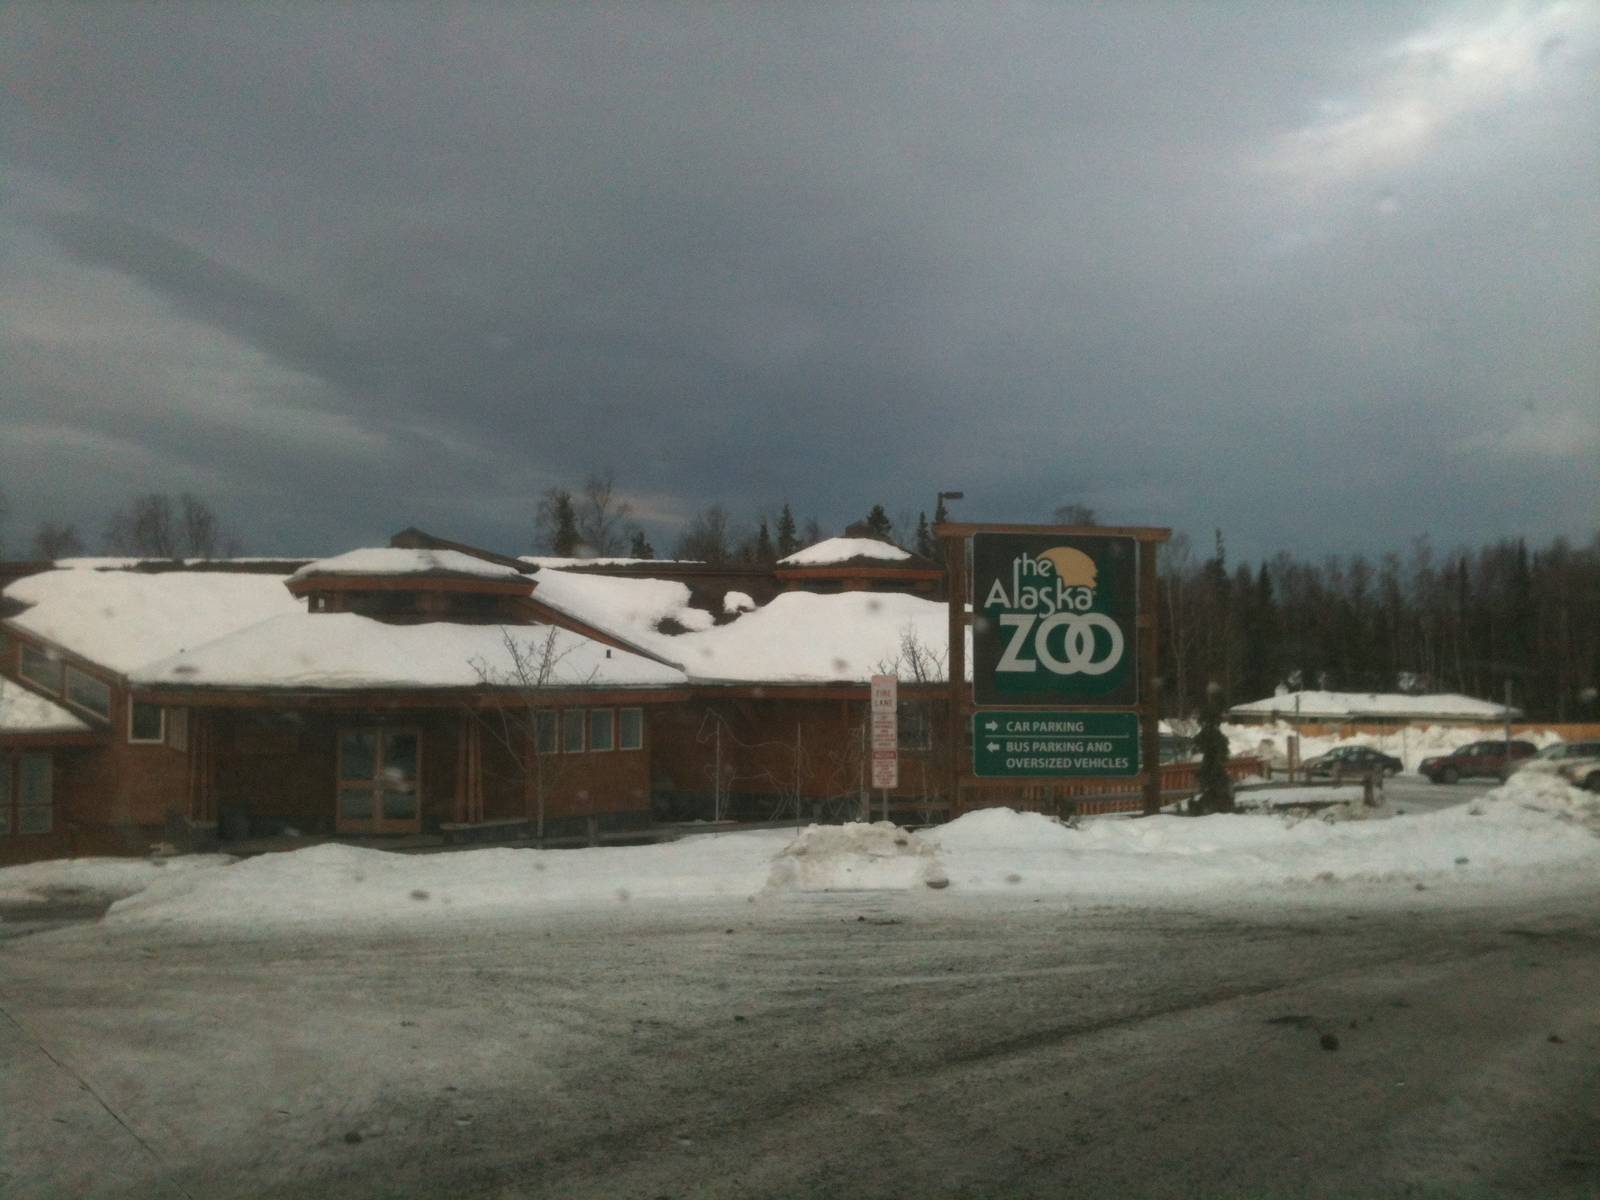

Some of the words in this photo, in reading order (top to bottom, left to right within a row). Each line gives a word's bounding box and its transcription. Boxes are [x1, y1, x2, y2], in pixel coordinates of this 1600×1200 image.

[1013, 552, 1052, 577] the
[984, 576, 1092, 618] Alaska
[995, 612, 1124, 675] ZOO
[1006, 721, 1030, 732] CAR
[1032, 721, 1084, 732] PARKING
[1006, 742, 1030, 752] BUS
[1032, 742, 1084, 752] PARKING
[1086, 742, 1113, 752] AND
[1006, 757, 1072, 769] OVERSIZED
[1073, 757, 1129, 769] VEHICLES
